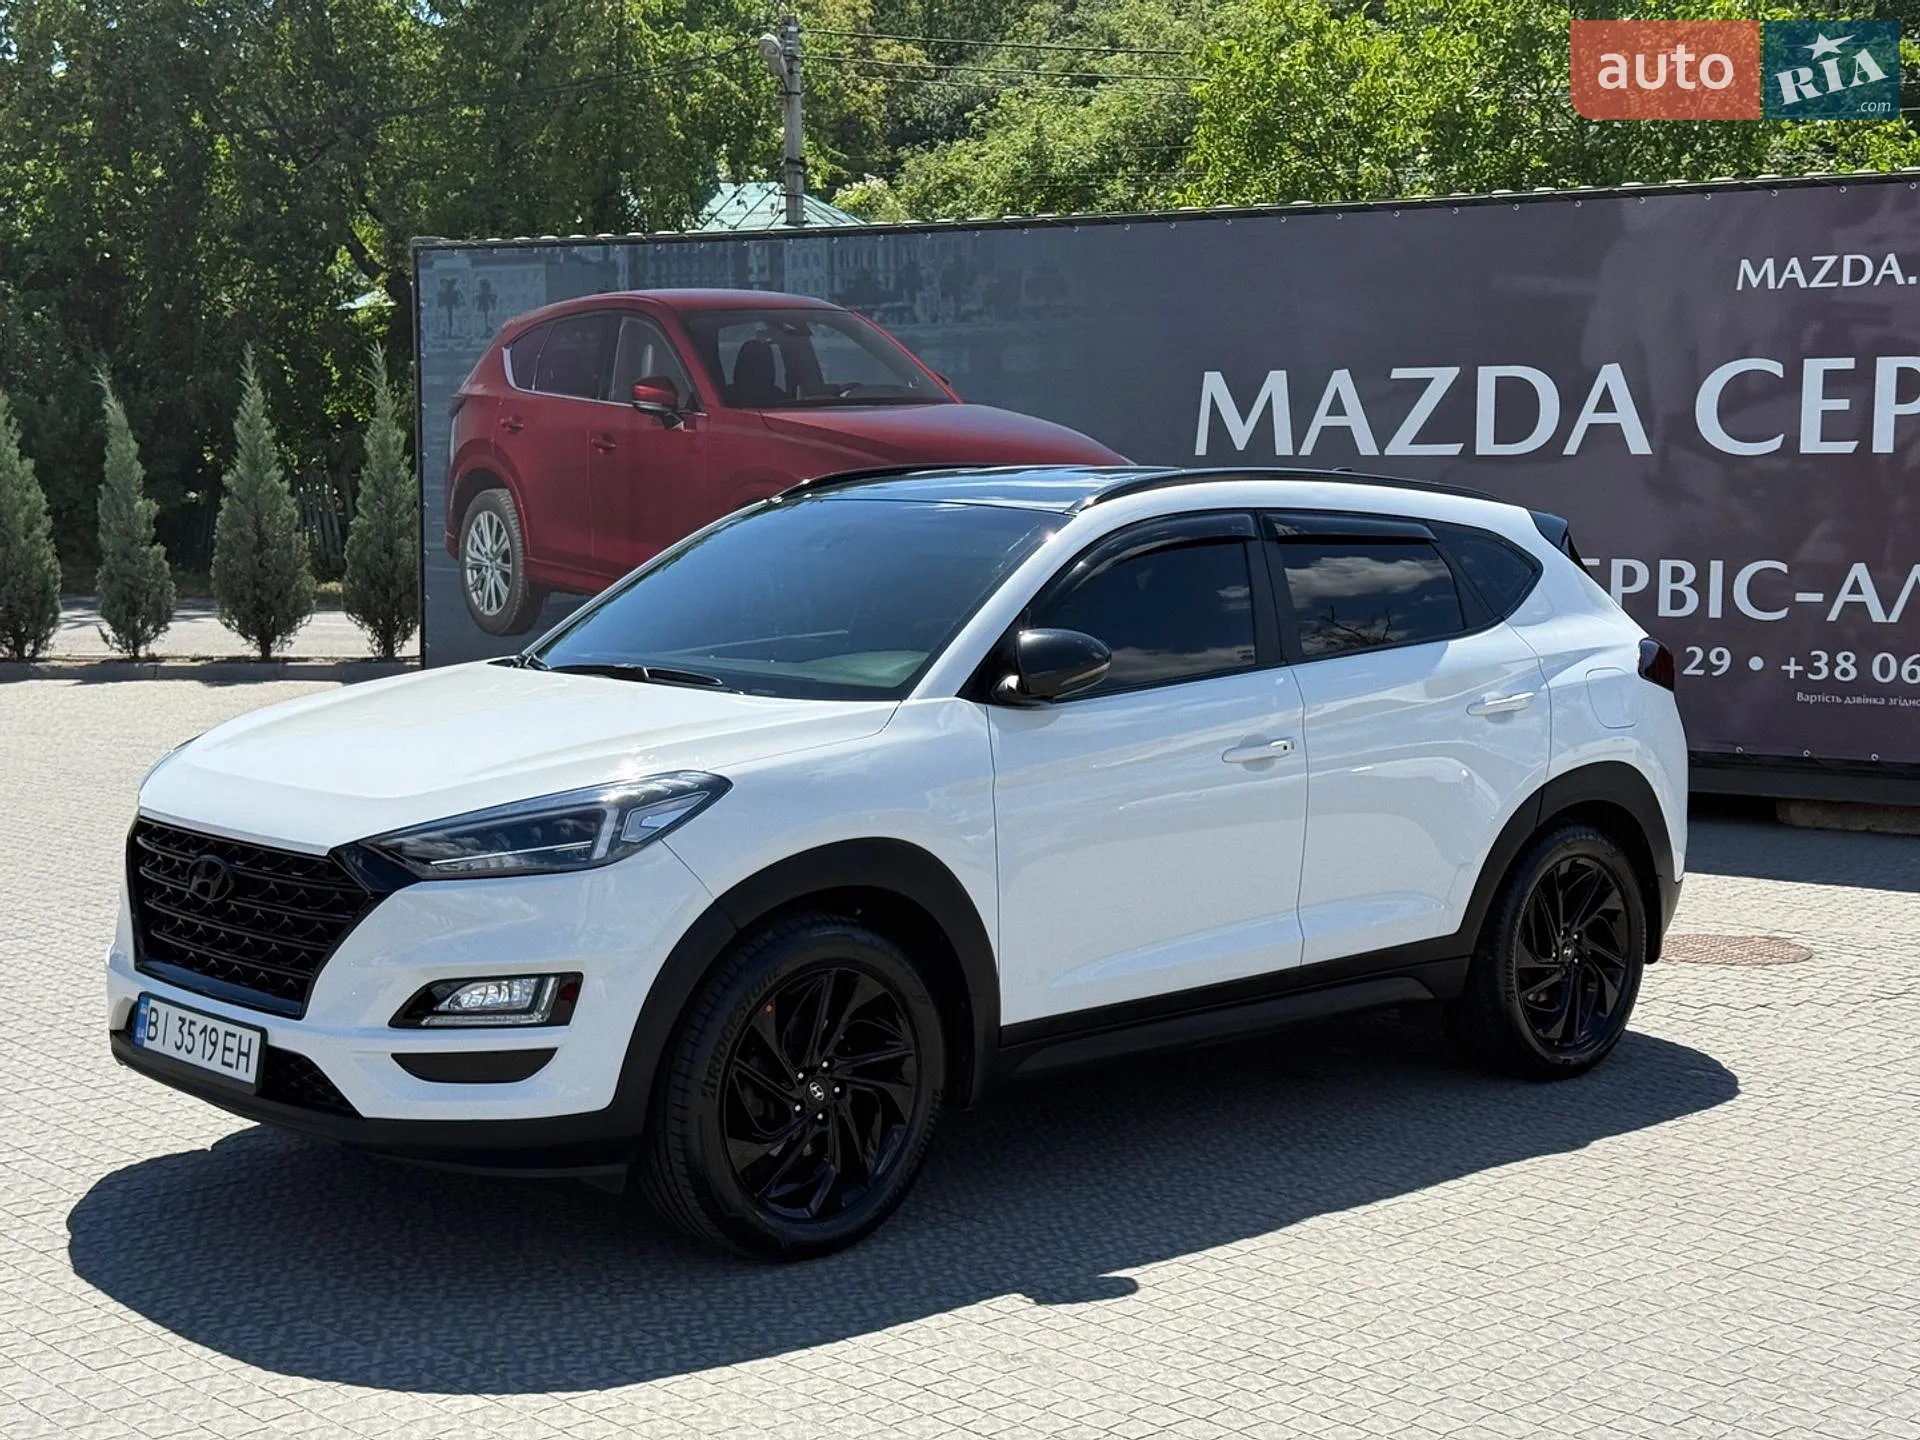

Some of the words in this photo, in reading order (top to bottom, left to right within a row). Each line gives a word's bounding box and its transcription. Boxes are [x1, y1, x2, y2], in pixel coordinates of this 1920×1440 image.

[1194, 362, 1654, 456] MAZDA
[1695, 356, 1920, 456] СЕР
[1682, 646, 1732, 677] 29
[1781, 651, 1857, 681] +38
[1871, 652, 1920, 684] 06
[174, 1016, 219, 1062] 3519
